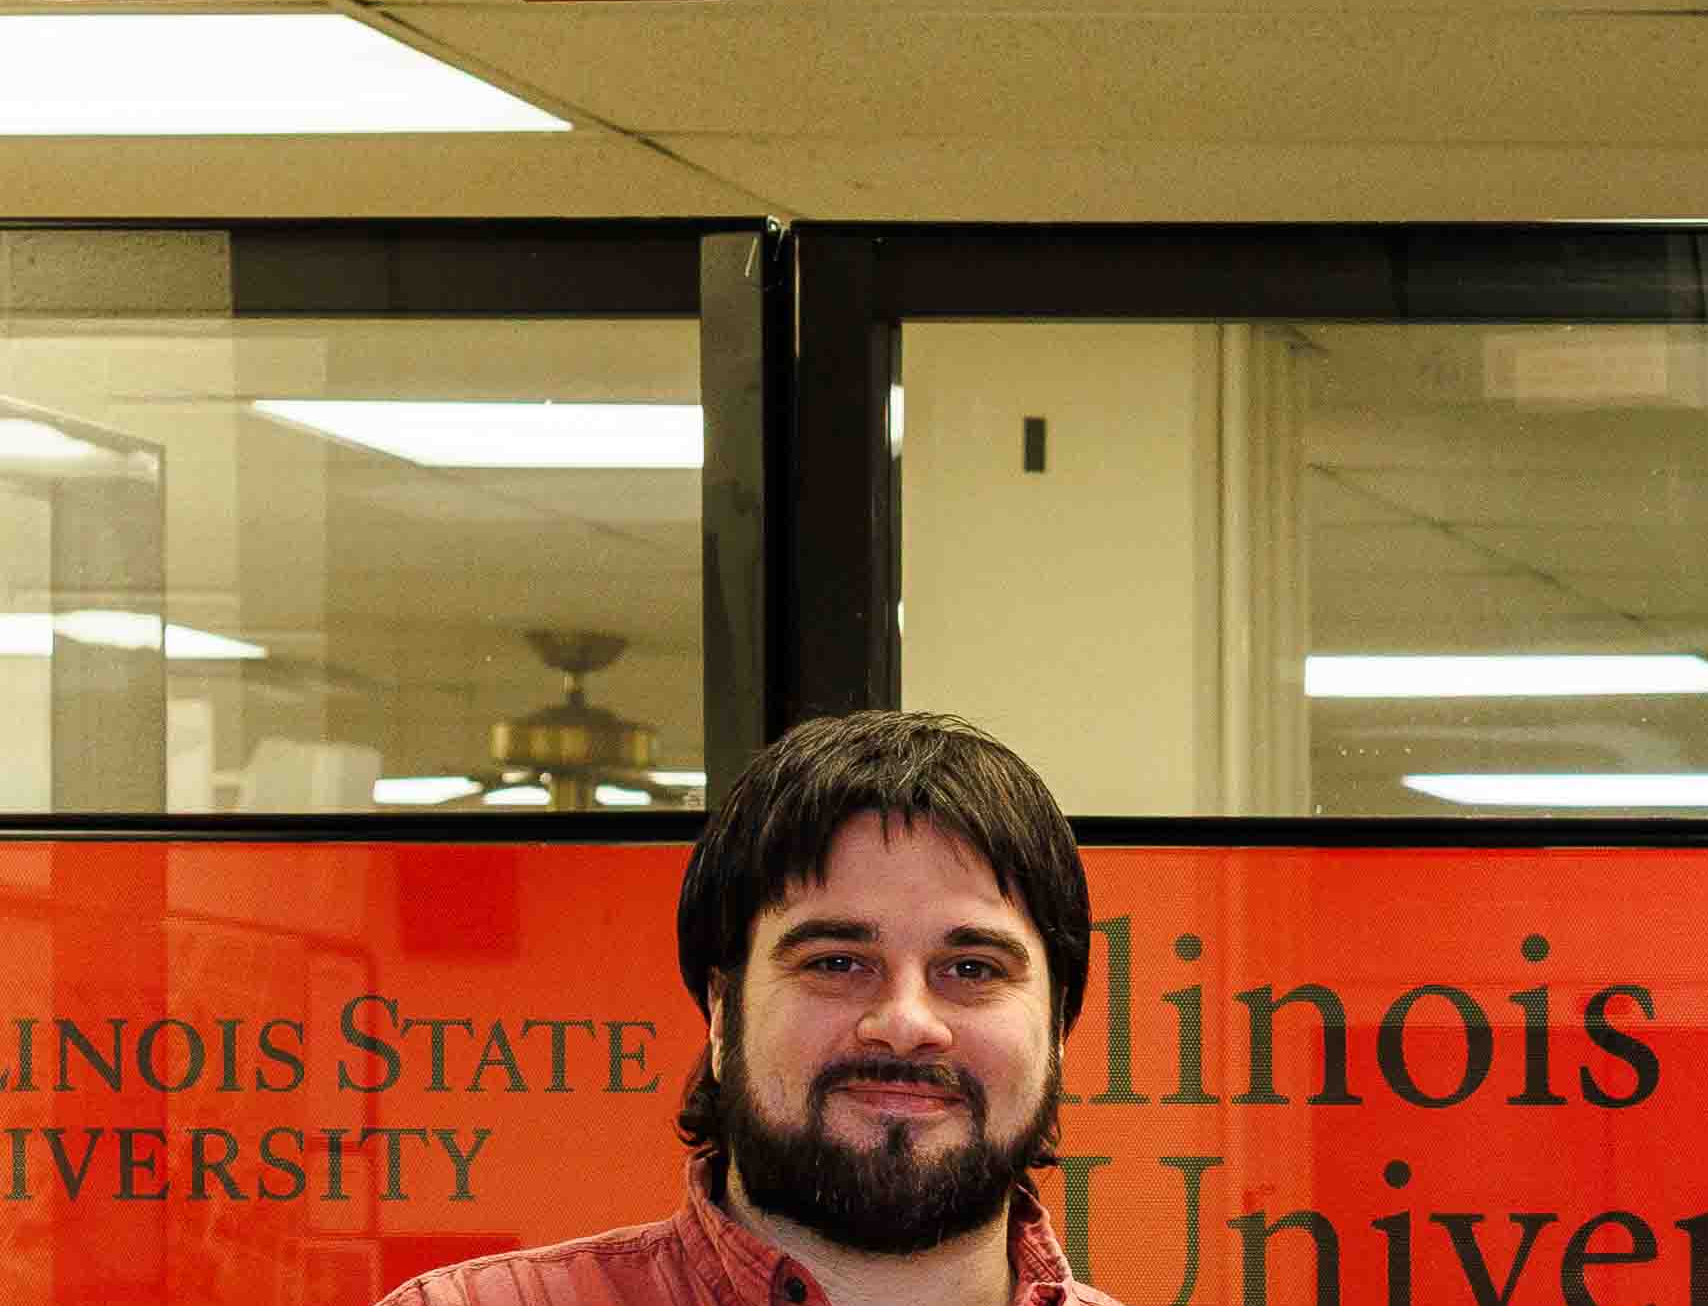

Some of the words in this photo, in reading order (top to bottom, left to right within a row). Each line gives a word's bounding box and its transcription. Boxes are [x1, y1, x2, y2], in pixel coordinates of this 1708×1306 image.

[0, 1015, 306, 1093] INOIS
[337, 995, 662, 1095] STATE
[1060, 915, 1661, 1109] linois
